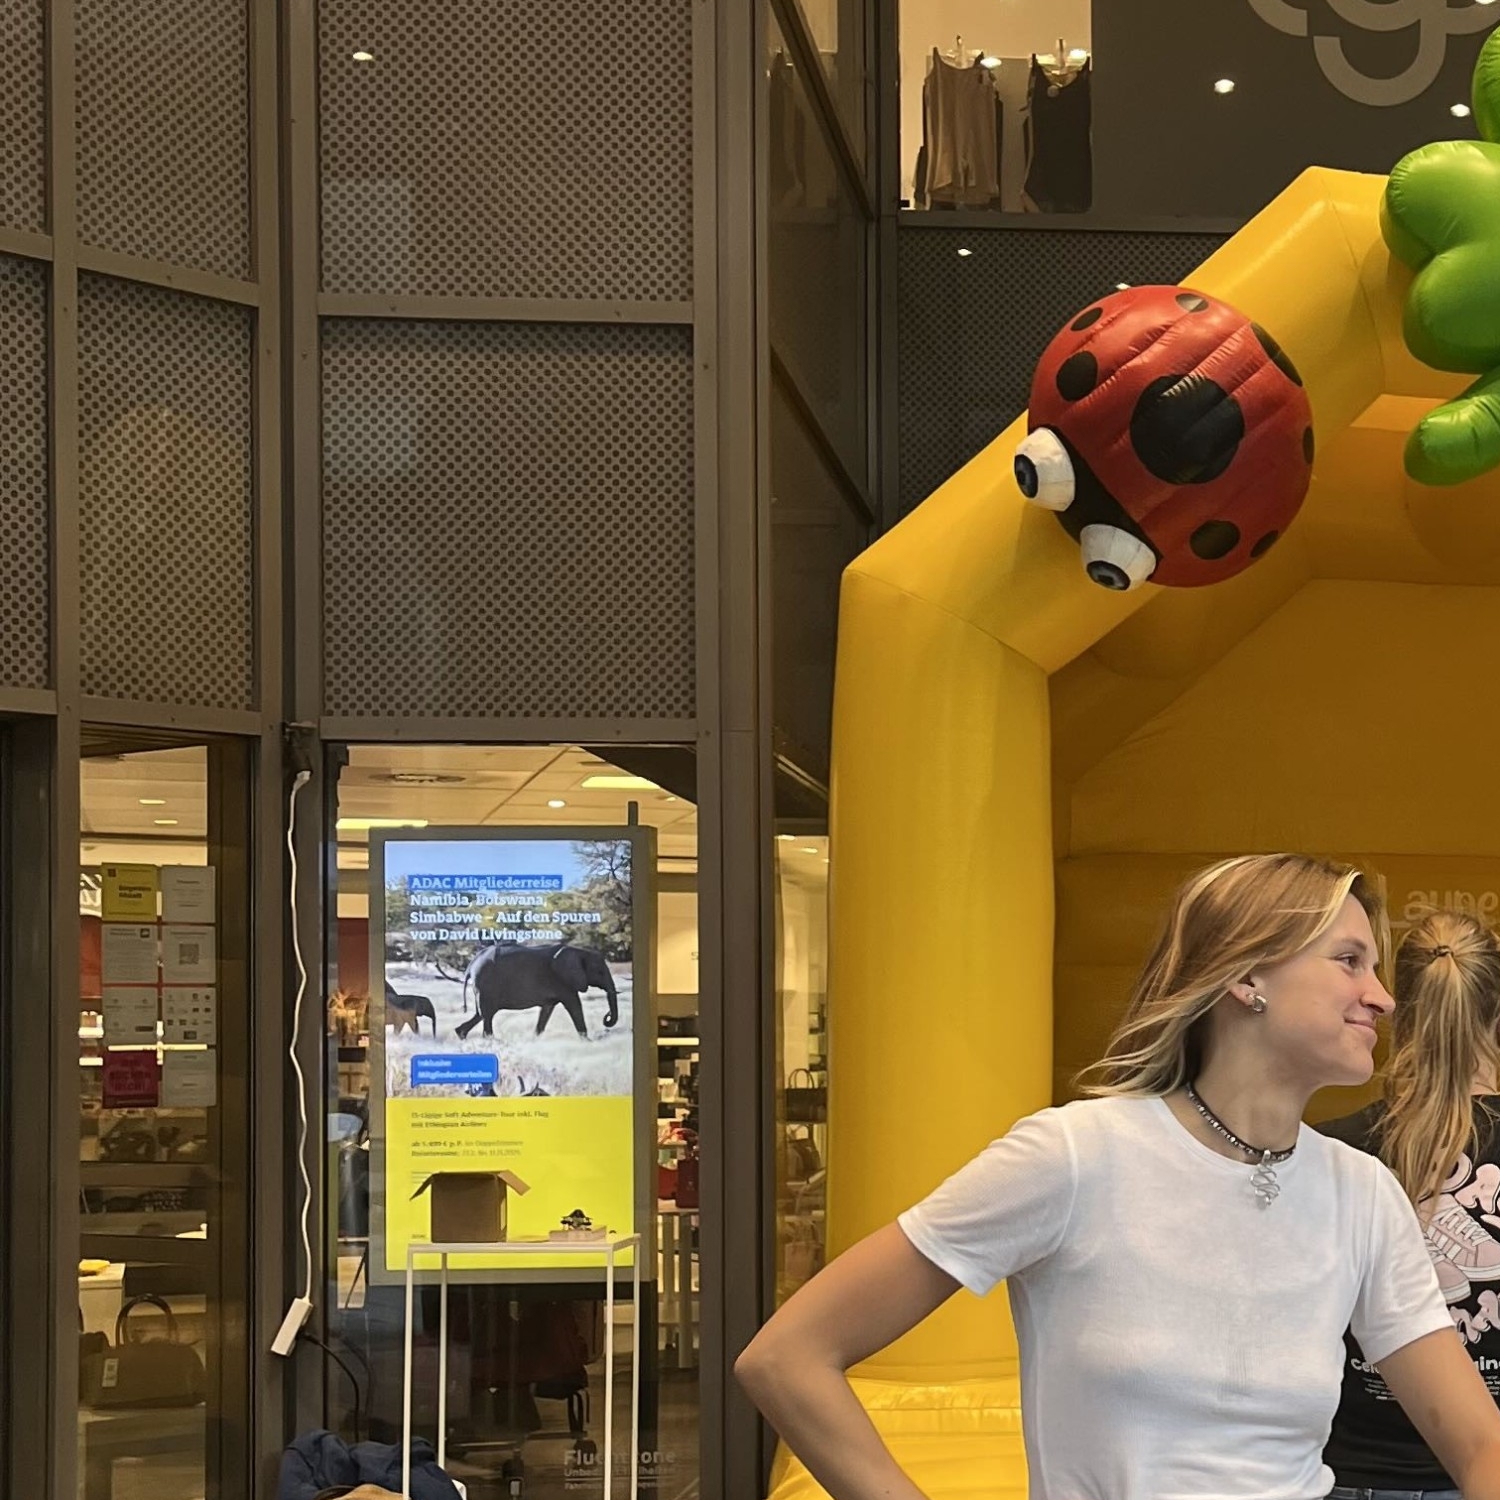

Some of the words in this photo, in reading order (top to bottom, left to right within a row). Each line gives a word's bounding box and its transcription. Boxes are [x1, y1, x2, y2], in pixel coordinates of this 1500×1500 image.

[412, 877, 451, 889] ADAC
[455, 877, 560, 890] Mitgliederreise
[410, 894, 472, 908] Namibia,
[476, 894, 547, 908] Botswana,
[410, 911, 482, 923] Simbabwe
[496, 912, 522, 923] Auf
[524, 912, 549, 923] den
[552, 912, 601, 926] Spuren
[410, 930, 435, 940] von
[440, 929, 478, 940] David
[482, 928, 563, 943] Livingstone
